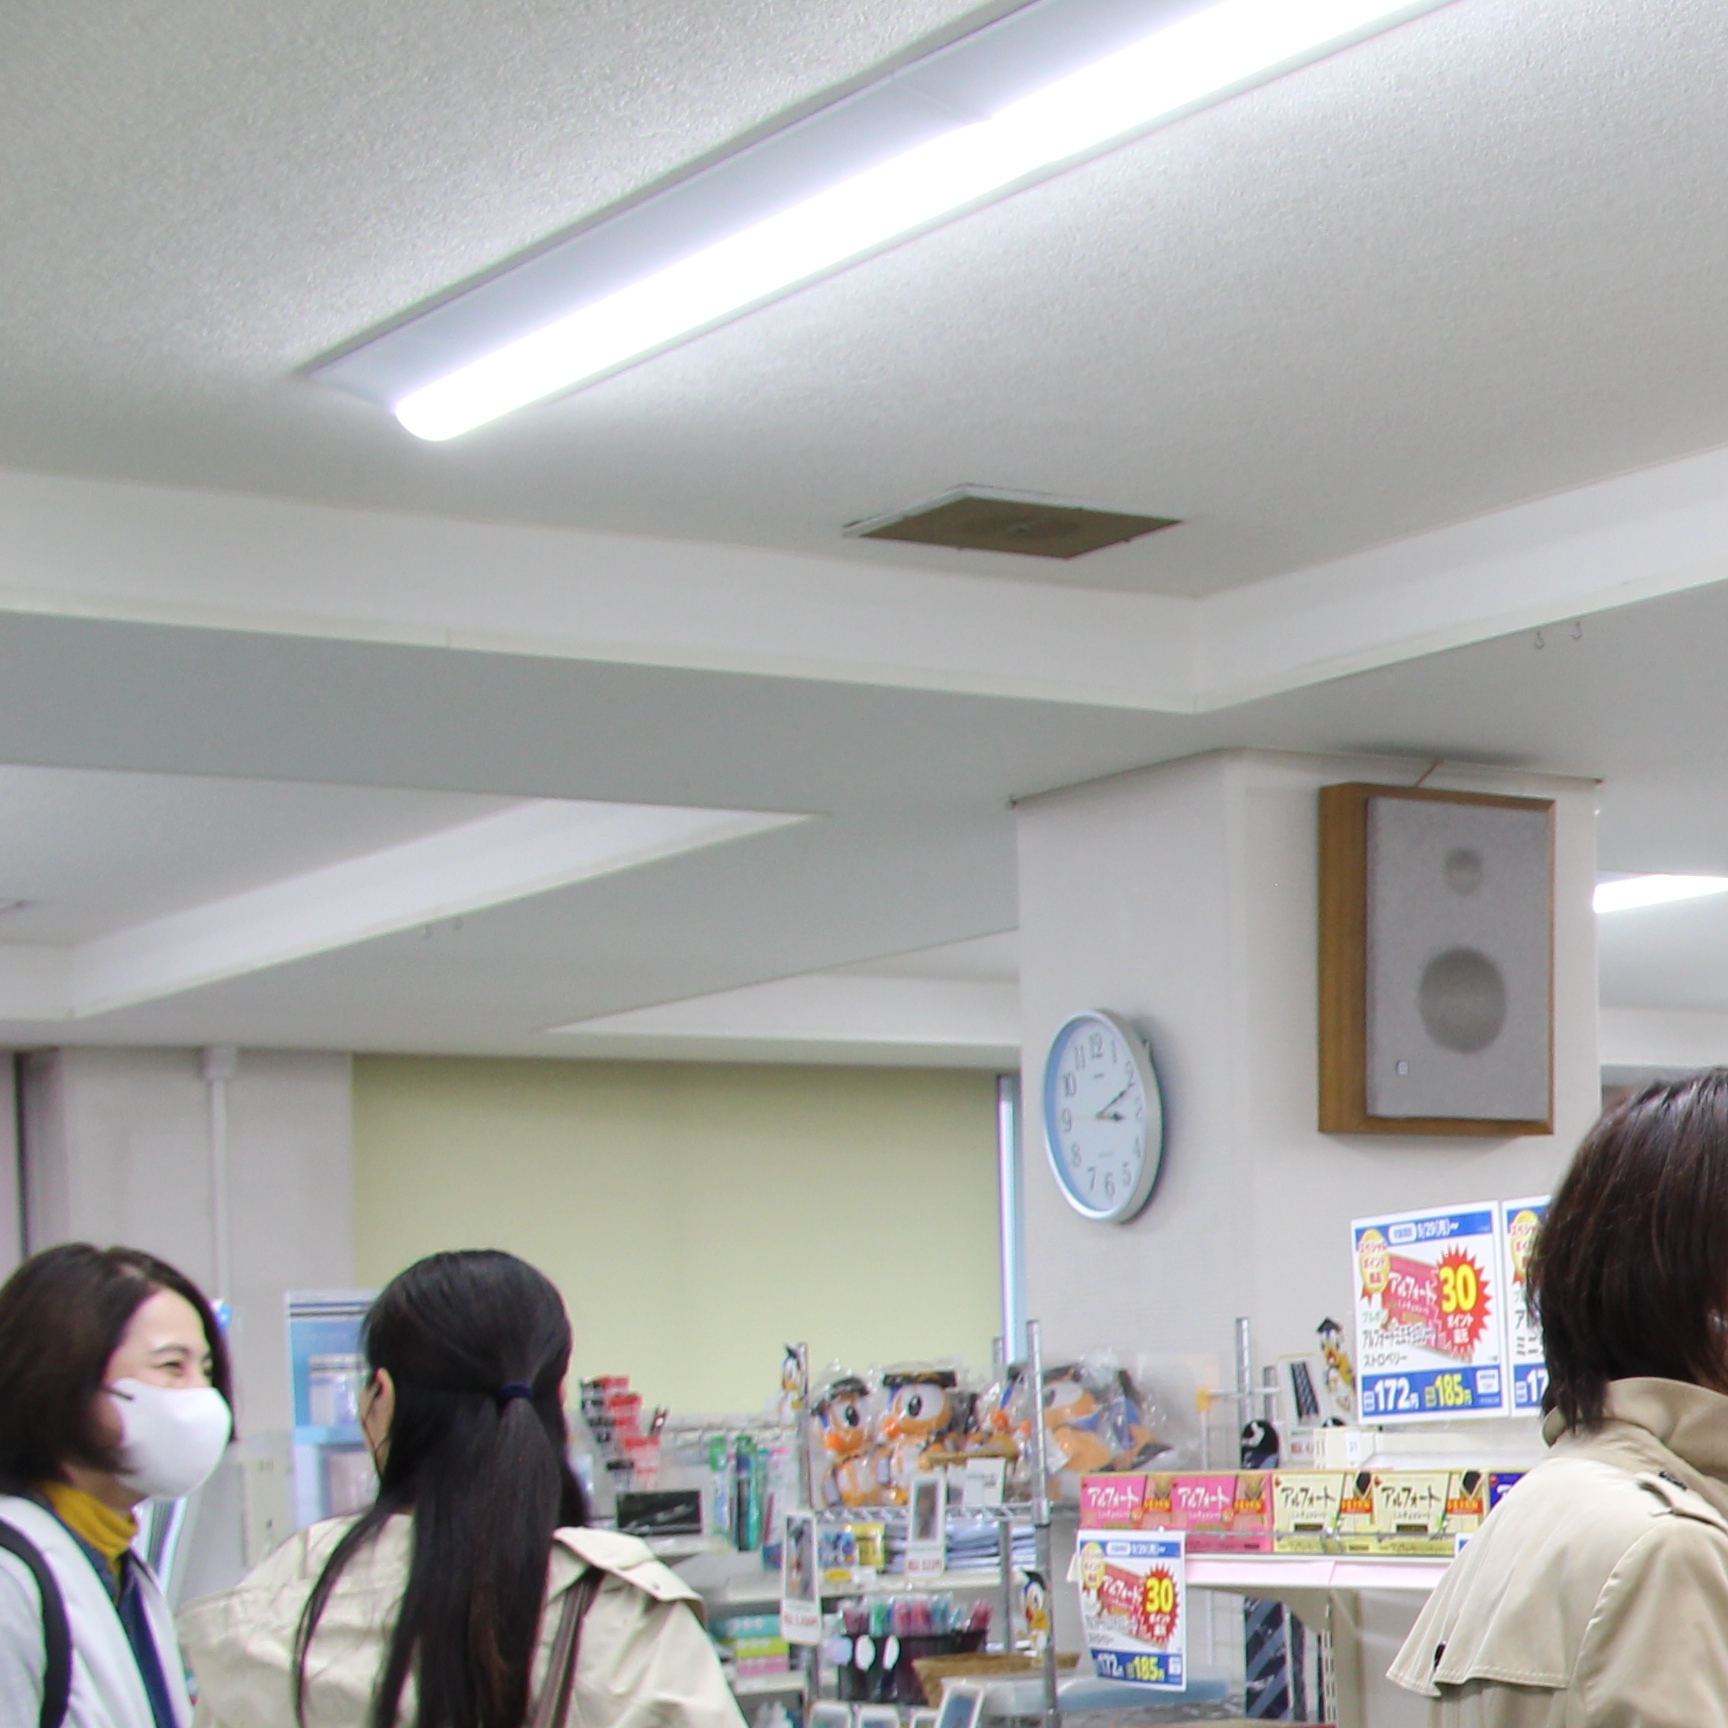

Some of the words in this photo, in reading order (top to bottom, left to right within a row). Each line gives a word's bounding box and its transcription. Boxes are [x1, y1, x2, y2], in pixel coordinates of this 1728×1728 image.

[1075, 1046, 1086, 1070] 11
[1089, 1032, 1103, 1059] 12
[1111, 1040, 1117, 1064] 1
[1063, 1073, 1077, 1097] 10
[1062, 1109, 1072, 1132] 9
[1072, 1142, 1081, 1168] 8
[1088, 1166, 1097, 1192] 7
[1105, 1173, 1115, 1197] 6
[1122, 1162, 1132, 1186] 5
[1438, 1264, 1477, 1313] 30
[1374, 1376, 1420, 1411] 172円
[1434, 1373, 1474, 1407] 185円
[1145, 1577, 1174, 1613] 30
